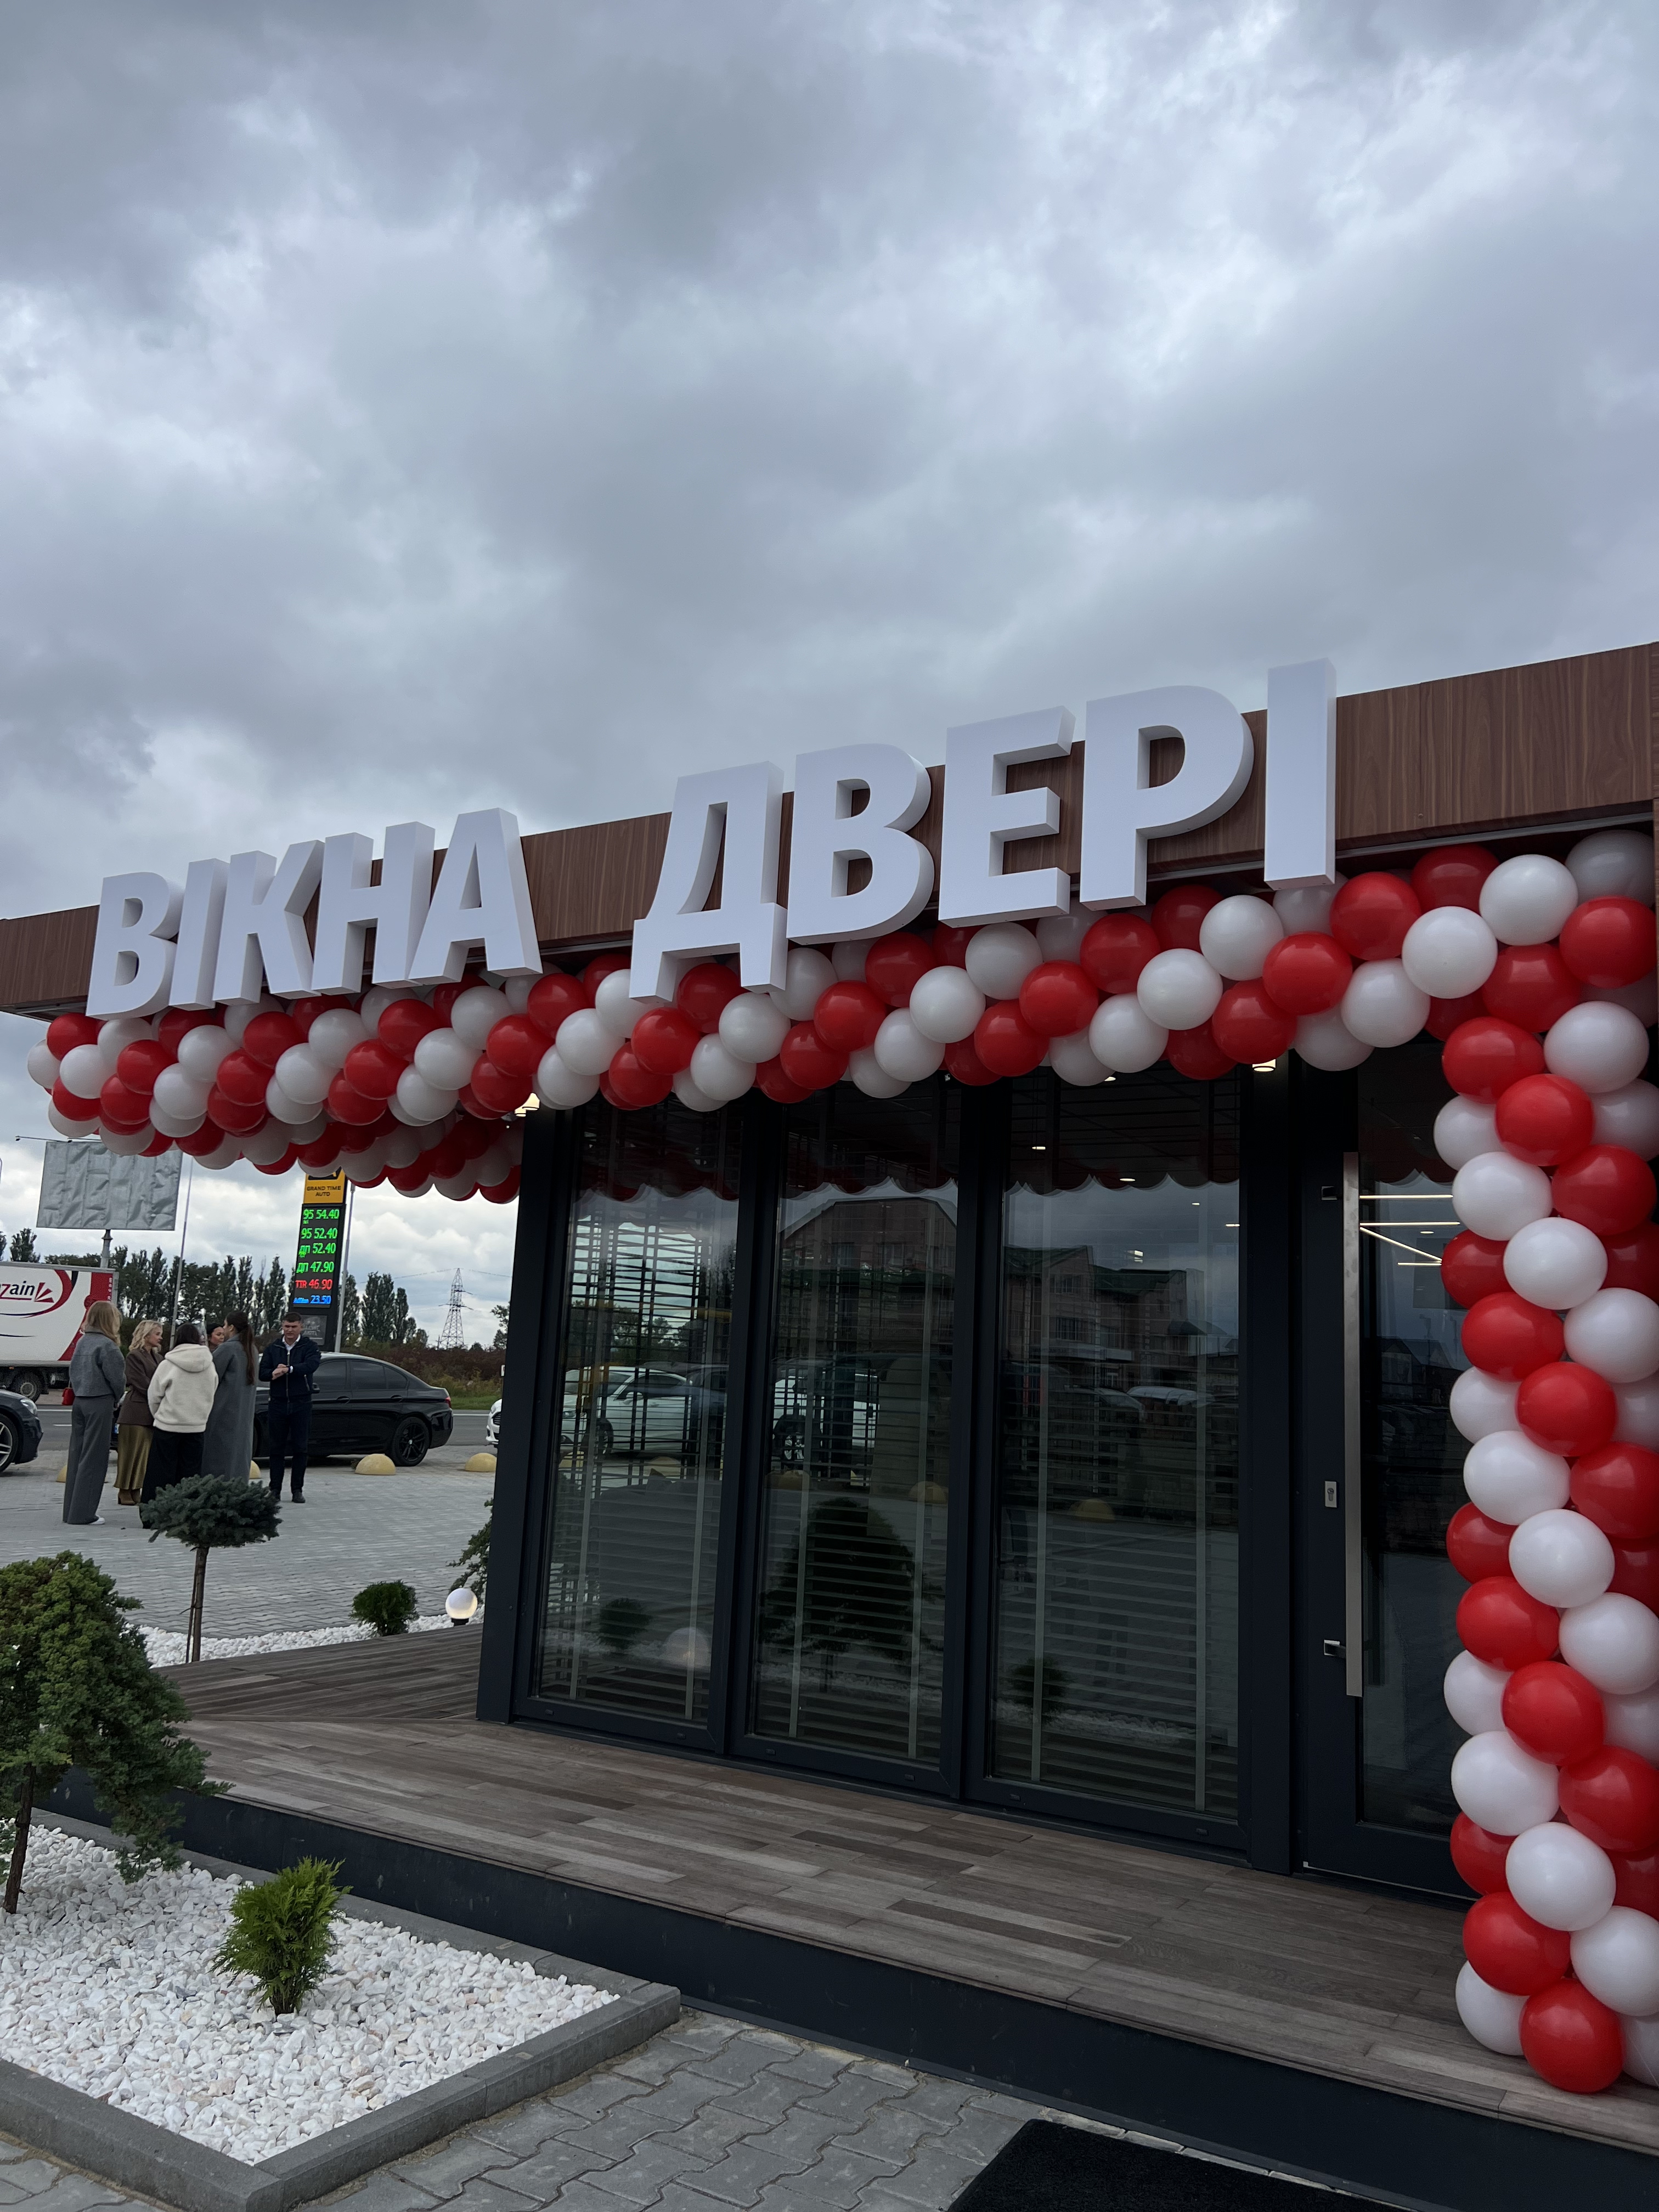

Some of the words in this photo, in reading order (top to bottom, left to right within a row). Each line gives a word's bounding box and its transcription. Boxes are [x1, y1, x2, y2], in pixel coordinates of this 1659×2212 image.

[86, 808, 543, 1019] ВІКНА
[629, 658, 1337, 1003] ДВЕРІ
[303, 1209, 314, 1219] 95
[315, 1209, 340, 1219] 54.40
[301, 1228, 312, 1239] 95
[314, 1228, 338, 1239] 52.40
[313, 1243, 336, 1254] 52.40
[310, 1261, 334, 1273] 47.90
[0, 1280, 35, 1300] zain
[308, 1279, 332, 1290] 46.90
